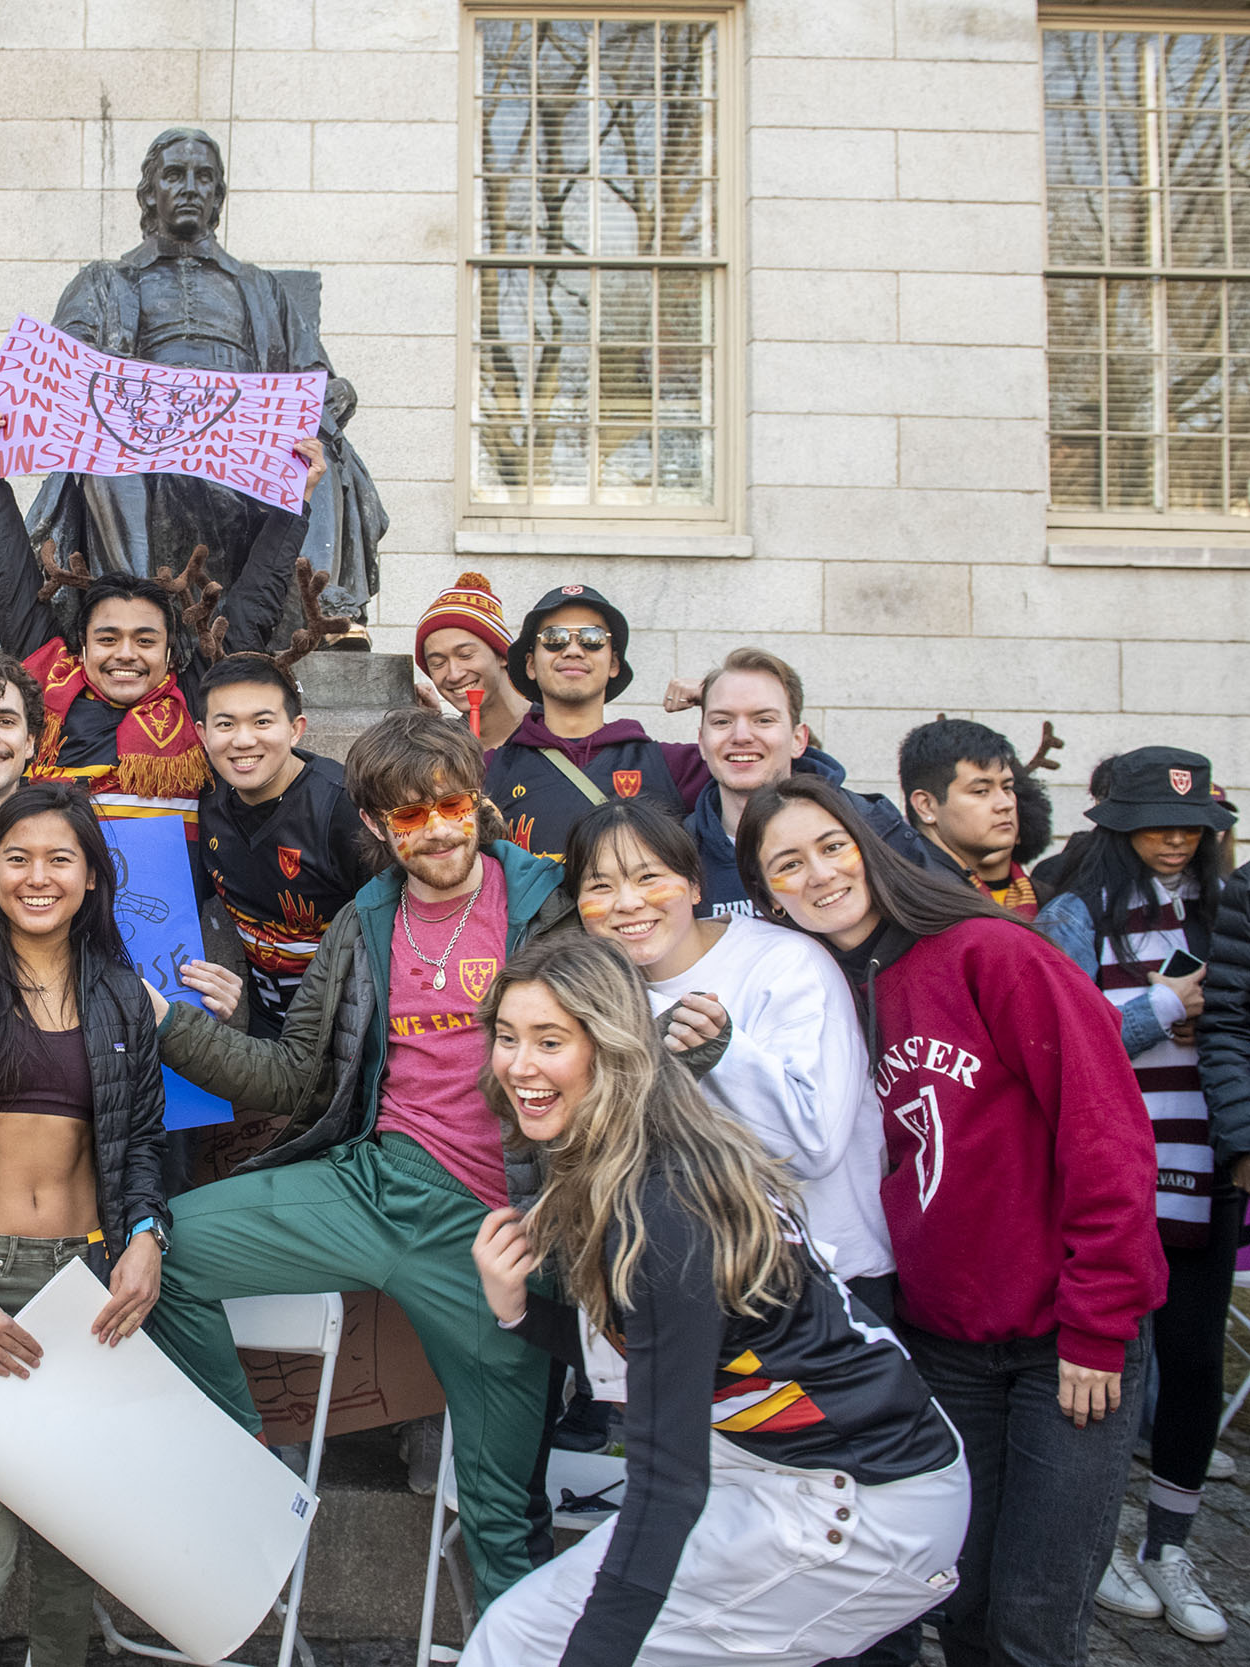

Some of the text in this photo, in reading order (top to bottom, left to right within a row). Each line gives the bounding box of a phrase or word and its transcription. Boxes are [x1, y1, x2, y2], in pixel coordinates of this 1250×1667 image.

[3, 336, 167, 406] DUNSTER
[17, 318, 318, 399] DUNSTER DUNSTER
[144, 458, 299, 512] DUNSTER
[152, 444, 298, 495] DUNSTER
[390, 1016, 425, 1037] WE
[1156, 1172, 1196, 1189] VARD
